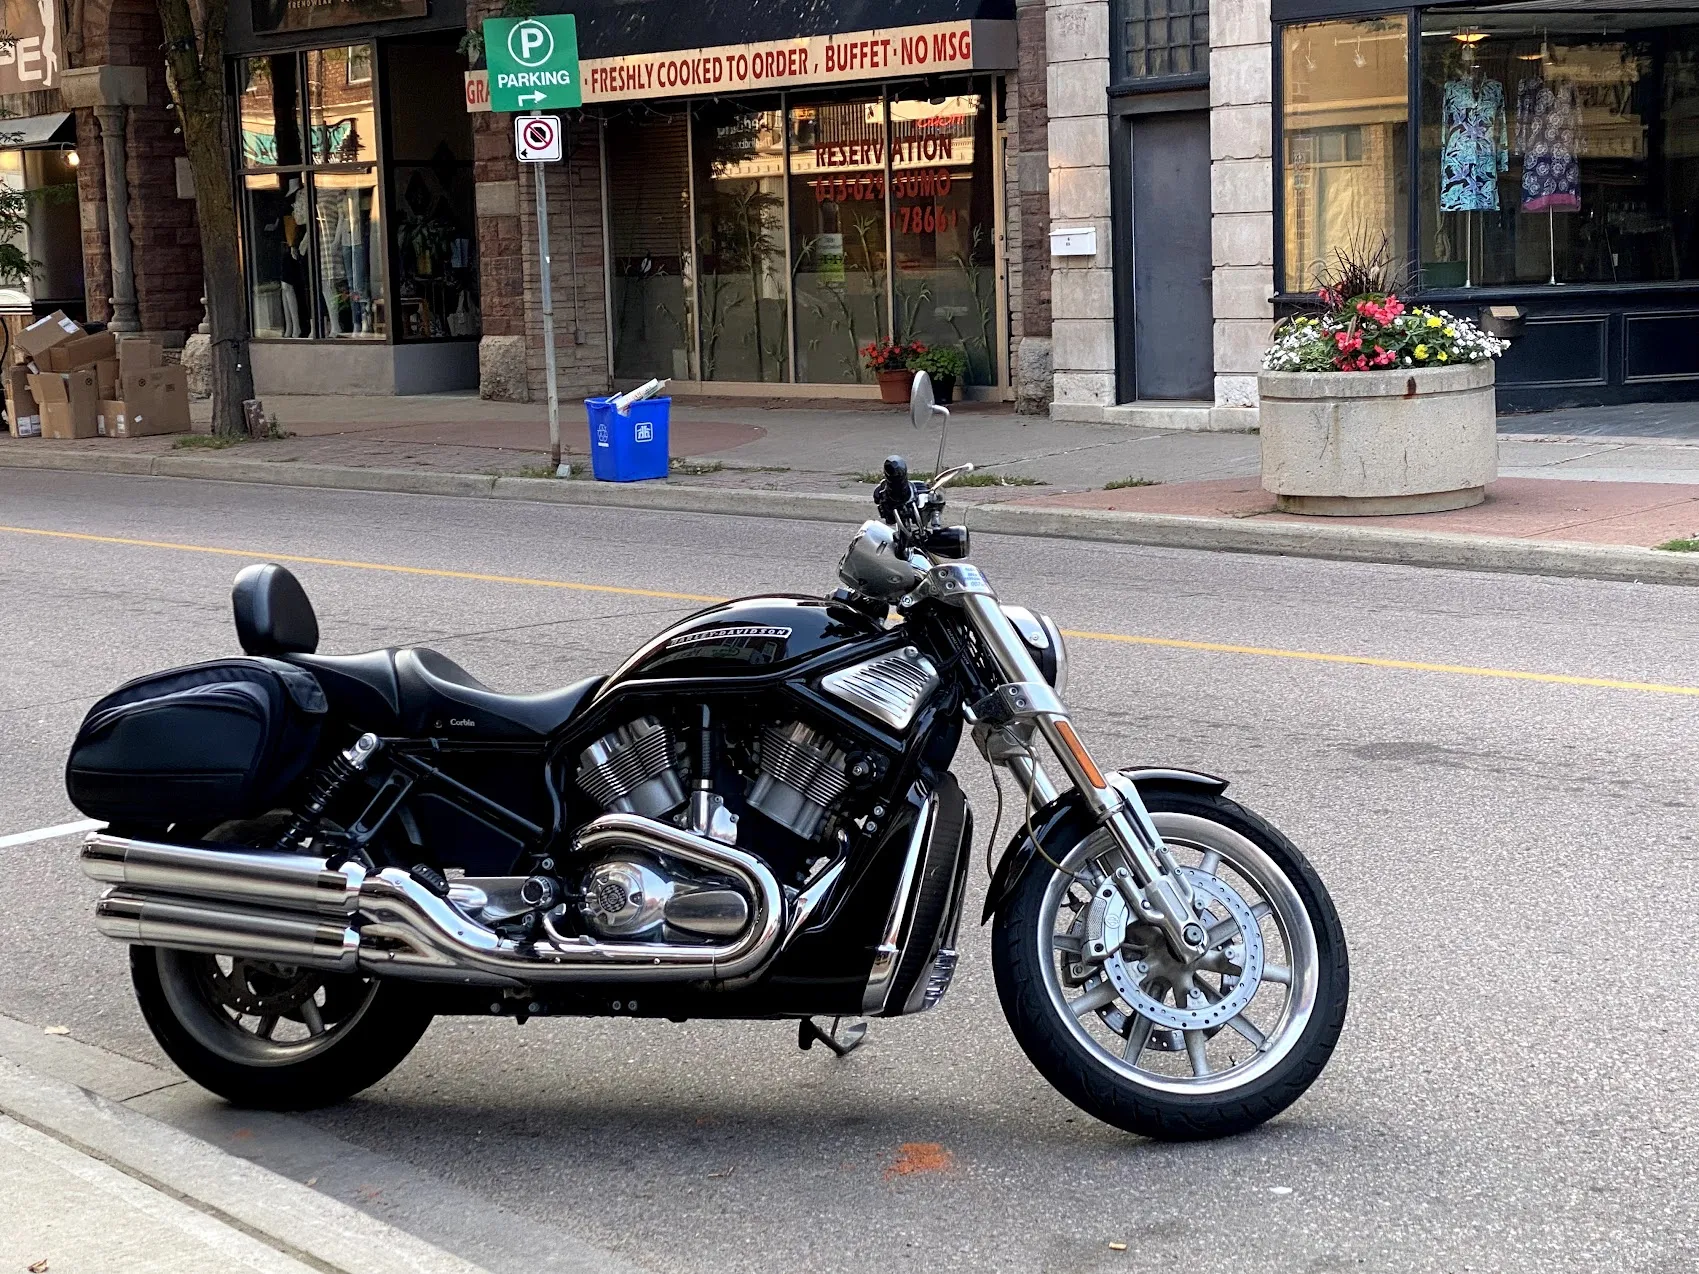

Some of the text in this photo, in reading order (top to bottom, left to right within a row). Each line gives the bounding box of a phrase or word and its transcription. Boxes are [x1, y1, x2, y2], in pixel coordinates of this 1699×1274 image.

[520, 27, 544, 59] P
[591, 62, 654, 94] FRESHLY
[657, 56, 723, 88] COOKED
[726, 53, 748, 82] TO
[825, 38, 891, 73] BUFFET
[901, 35, 928, 65] NO
[933, 30, 971, 62] MSG
[497, 70, 571, 89] PARKING
[815, 134, 952, 168] RESERVATION
[669, 628, 787, 646] HARLEY-DAVIDSON
[449, 718, 476, 727] Corbin
